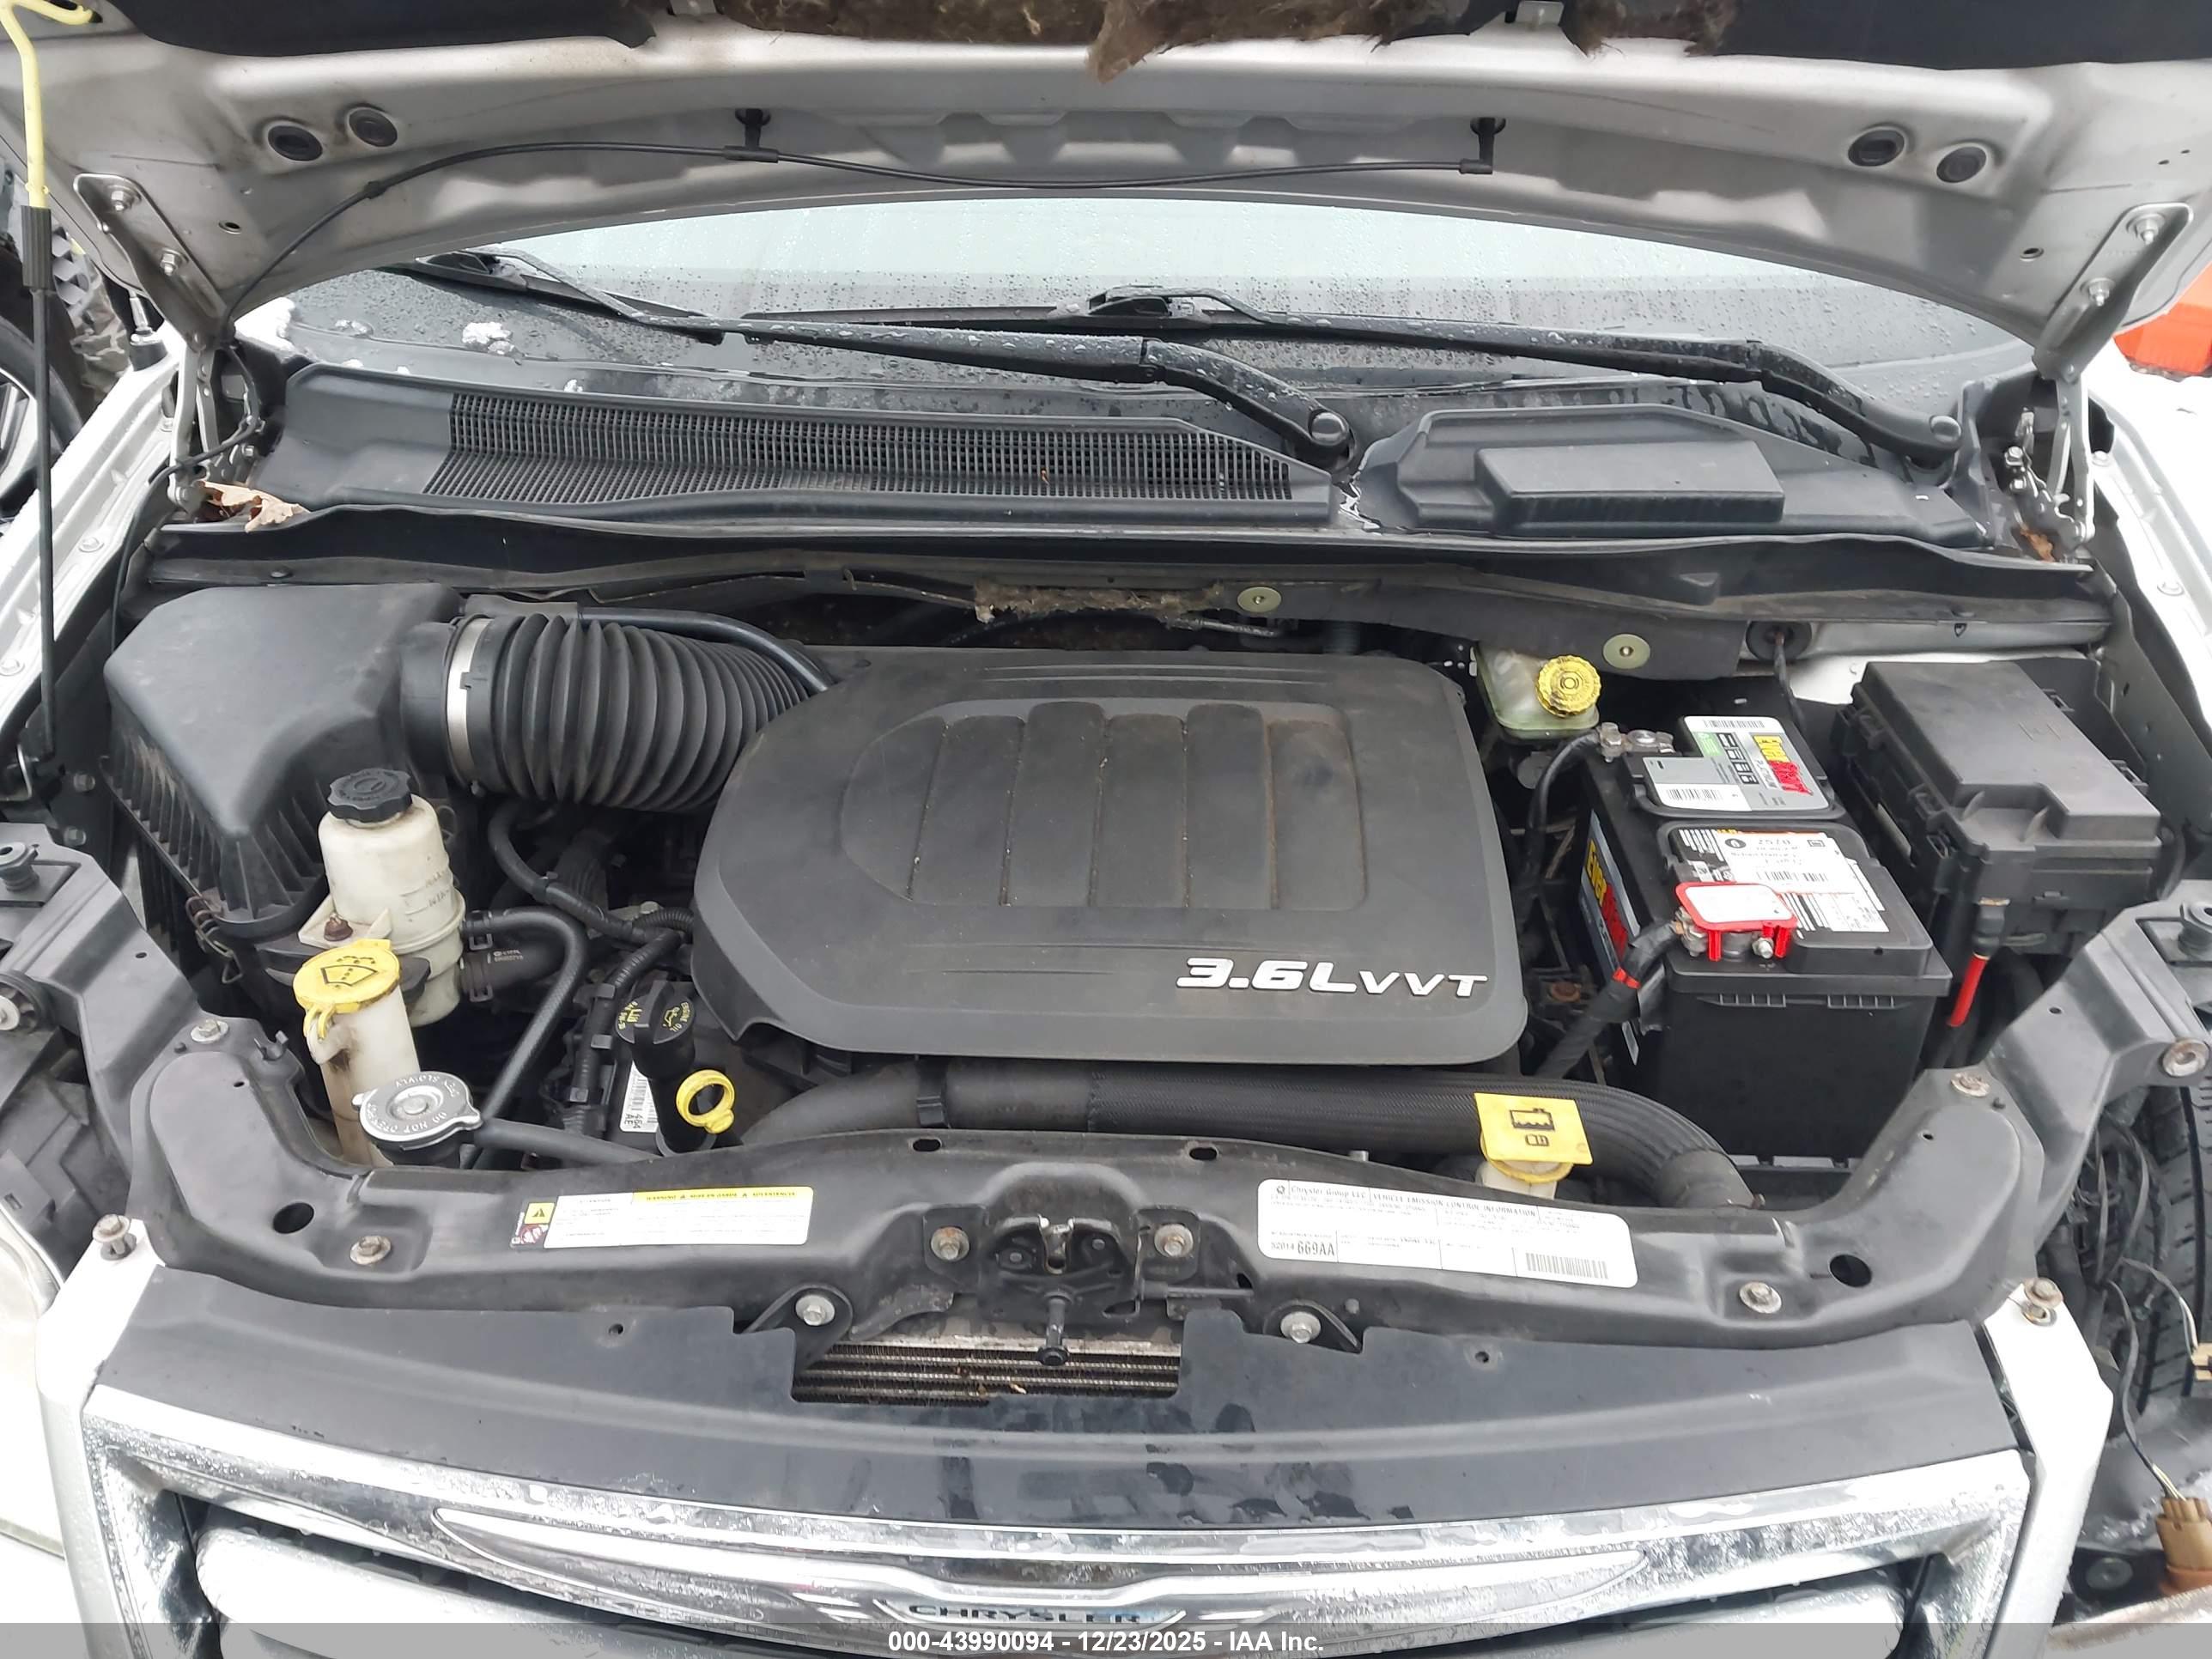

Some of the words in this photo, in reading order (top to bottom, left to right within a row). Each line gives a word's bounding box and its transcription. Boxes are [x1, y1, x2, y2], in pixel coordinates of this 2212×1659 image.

[1176, 957, 1357, 993] 3.6L
[1359, 970, 1488, 997] VVT
[680, 1002, 690, 1022] ENGINE
[670, 1023, 682, 1032] OIL
[432, 1111, 447, 1123] DO
[624, 1113, 635, 1125] AE
[404, 1121, 428, 1133] NOT
[1291, 1185, 1322, 1194] Chrysler
[1326, 1187, 1349, 1198] Group
[1373, 1193, 1403, 1202] VEHICLE
[1407, 1196, 1443, 1207] EMISSION
[1446, 1200, 1480, 1211] CONTROL
[1483, 1204, 1536, 1217] INFORMATION
[1297, 1240, 1335, 1256] 669AA
[909, 1604, 1140, 1623] CHRYSLER
